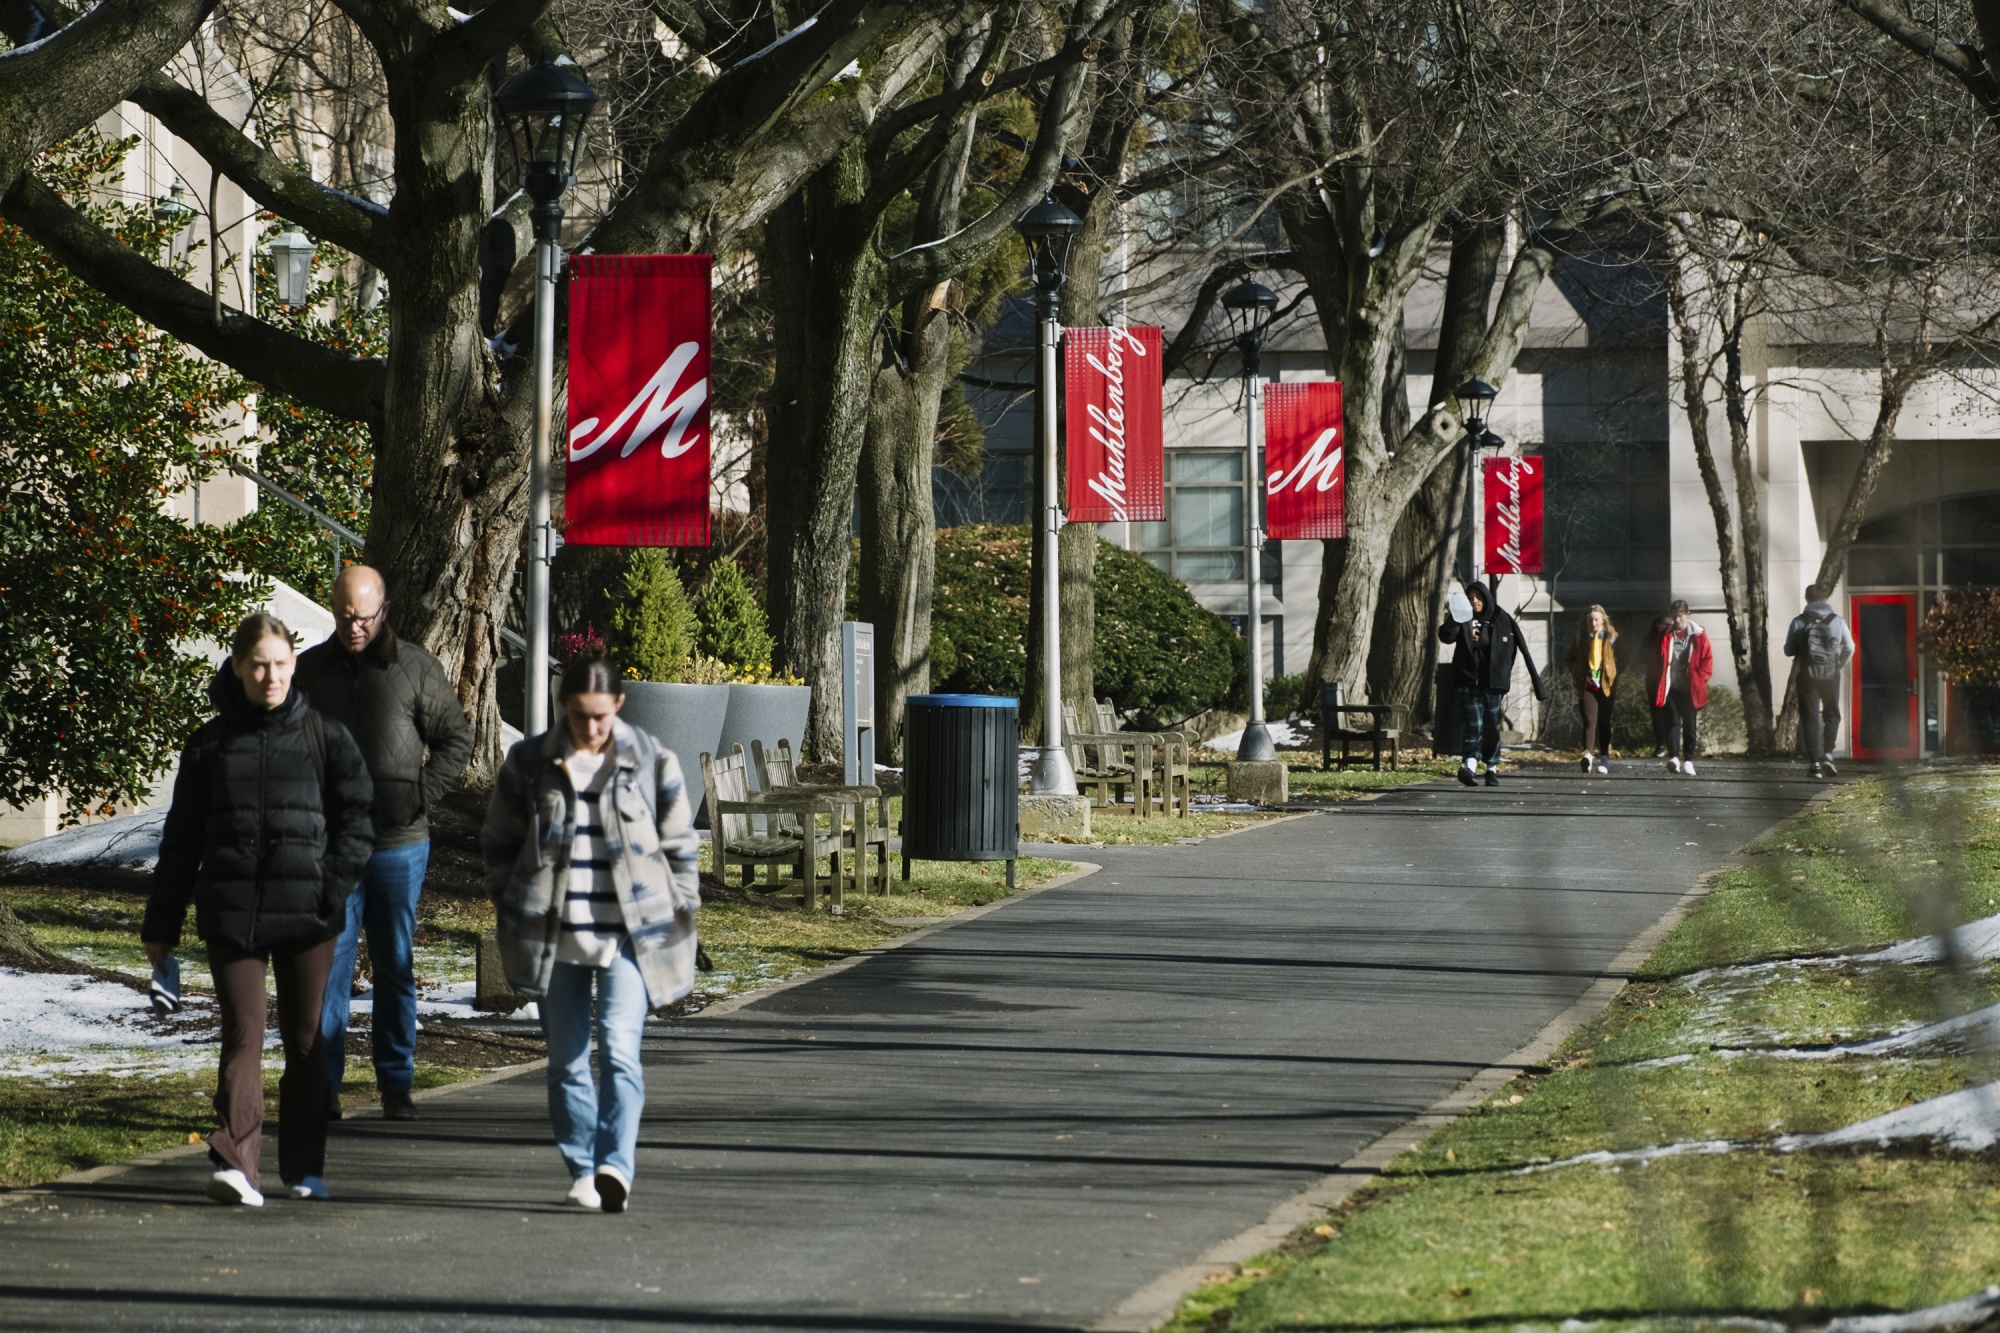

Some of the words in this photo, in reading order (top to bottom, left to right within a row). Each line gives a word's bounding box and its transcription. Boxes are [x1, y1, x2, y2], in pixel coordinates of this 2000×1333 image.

[570, 341, 707, 462] M
[1086, 326, 1146, 521] Muhlenberg
[1268, 428, 1341, 495] M
[1496, 456, 1534, 574] Muhlenberg
